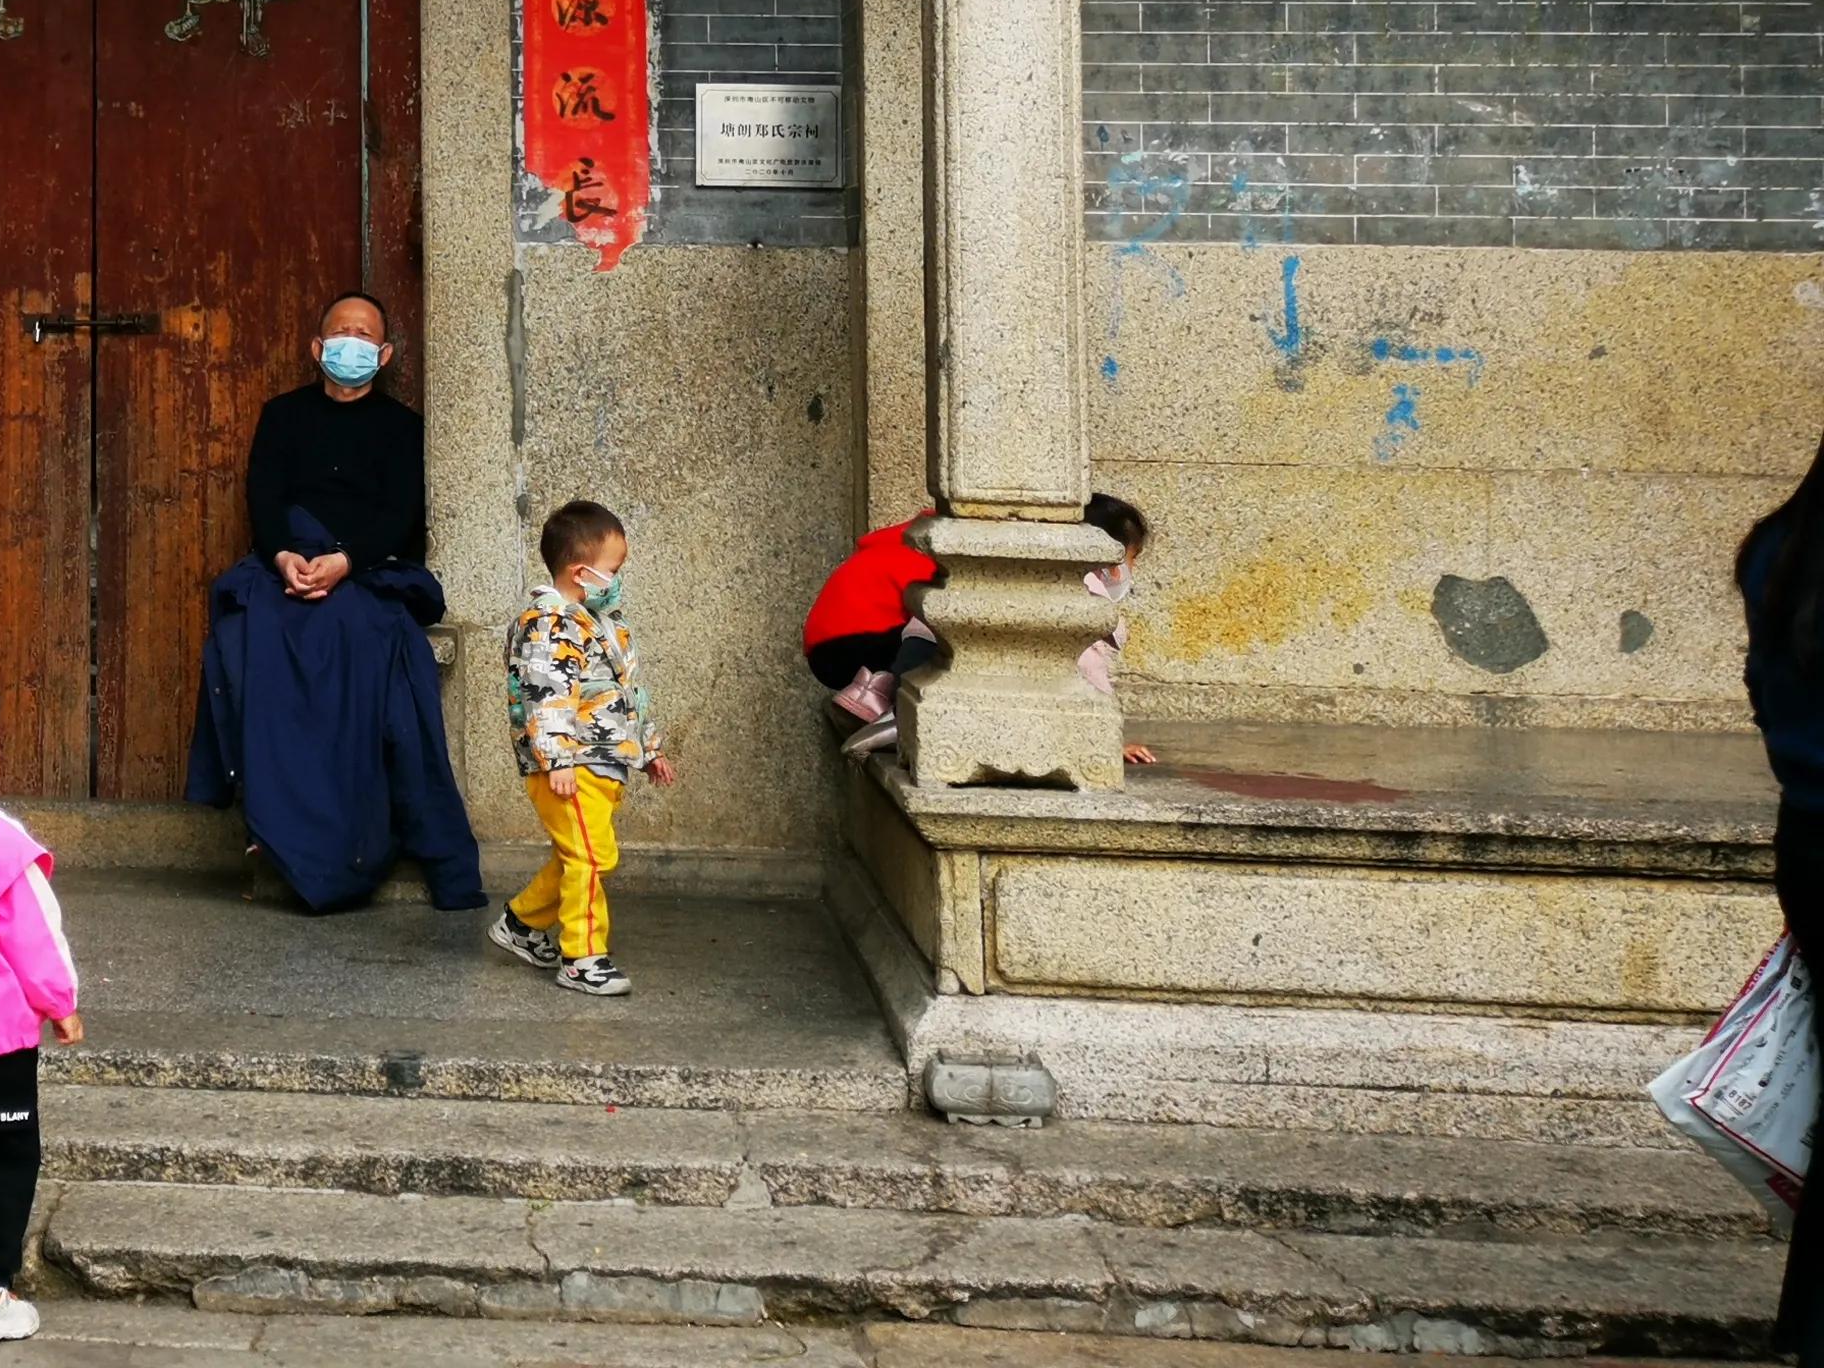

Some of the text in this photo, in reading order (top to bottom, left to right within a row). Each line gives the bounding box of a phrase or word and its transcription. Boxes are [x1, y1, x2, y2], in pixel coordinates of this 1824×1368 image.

[720, 122, 819, 139] 塘朗郑氏宗祠
